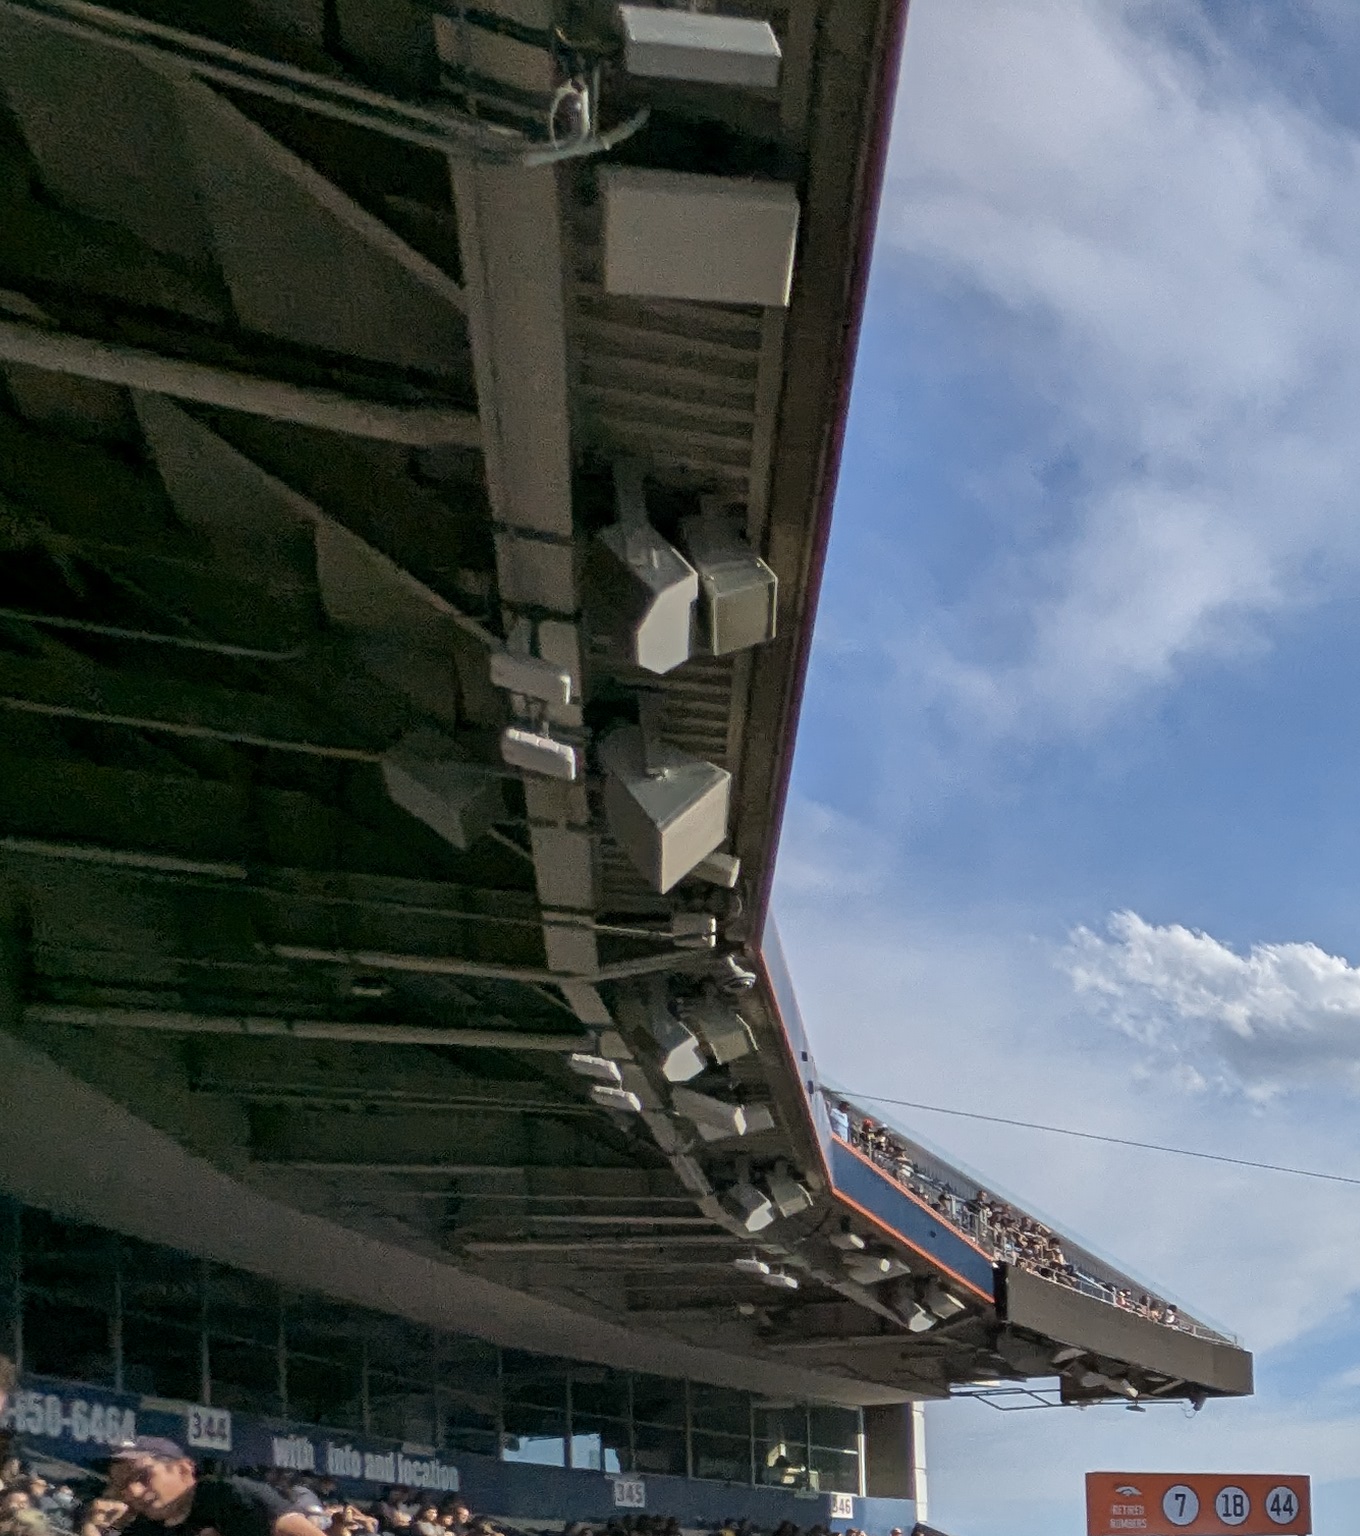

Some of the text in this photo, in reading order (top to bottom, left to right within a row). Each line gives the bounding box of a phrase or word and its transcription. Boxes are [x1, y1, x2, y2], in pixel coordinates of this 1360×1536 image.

[364, 1451, 395, 1483] and
[398, 1454, 459, 1492] location
[1175, 1494, 1187, 1517] 7
[1222, 1494, 1244, 1517] 18
[1270, 1494, 1293, 1516] 44
